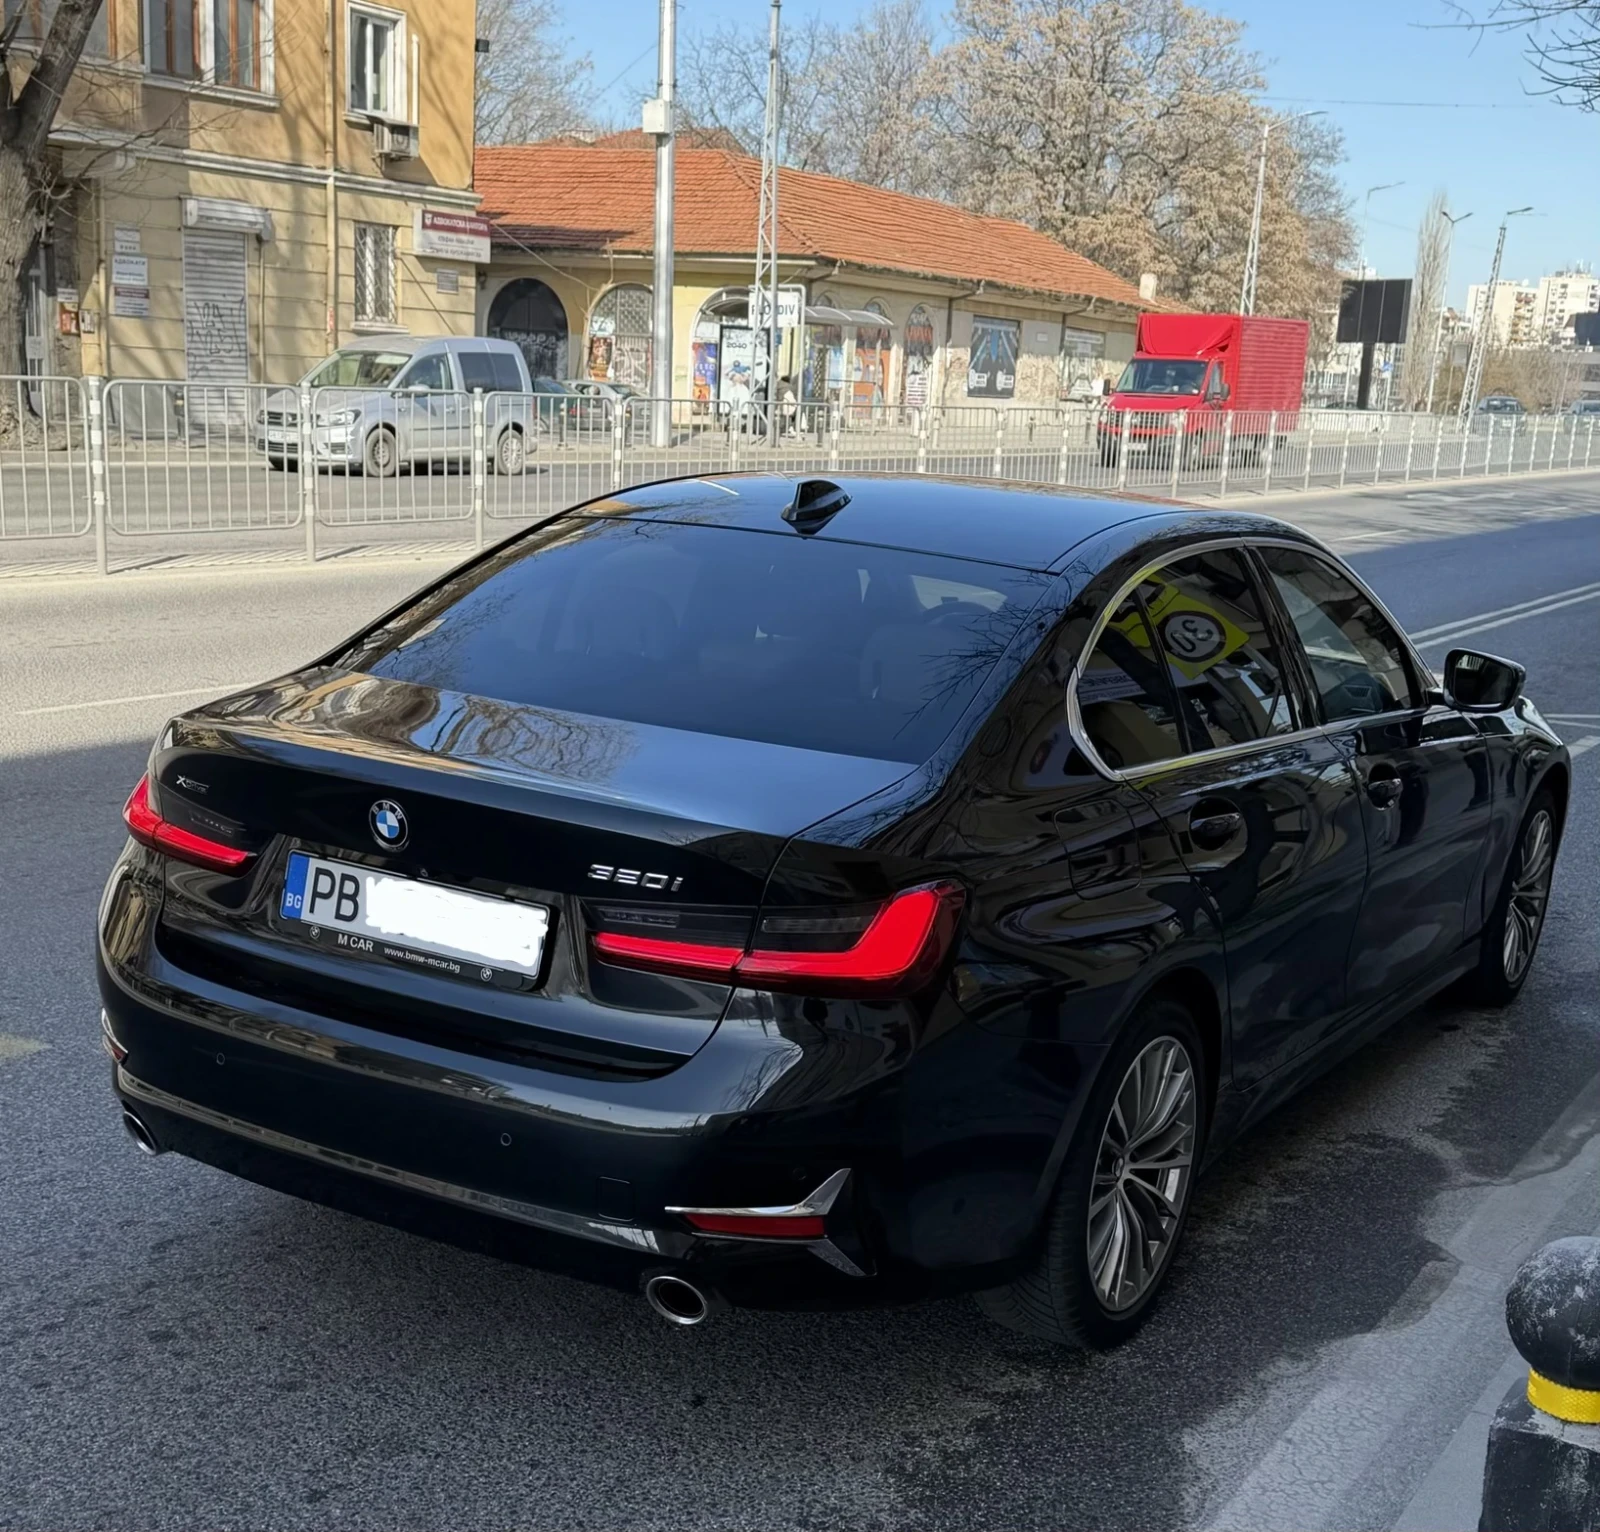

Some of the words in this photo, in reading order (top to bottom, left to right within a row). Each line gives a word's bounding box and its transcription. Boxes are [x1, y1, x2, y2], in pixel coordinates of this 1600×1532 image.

[372, 802, 403, 820] BMW
[587, 863, 684, 892] 320i
[285, 892, 303, 909] BG
[309, 866, 360, 922] PB
[337, 933, 348, 946] M
[350, 937, 374, 952] CAR
[383, 946, 461, 974] www.bmw-mcar.bg
